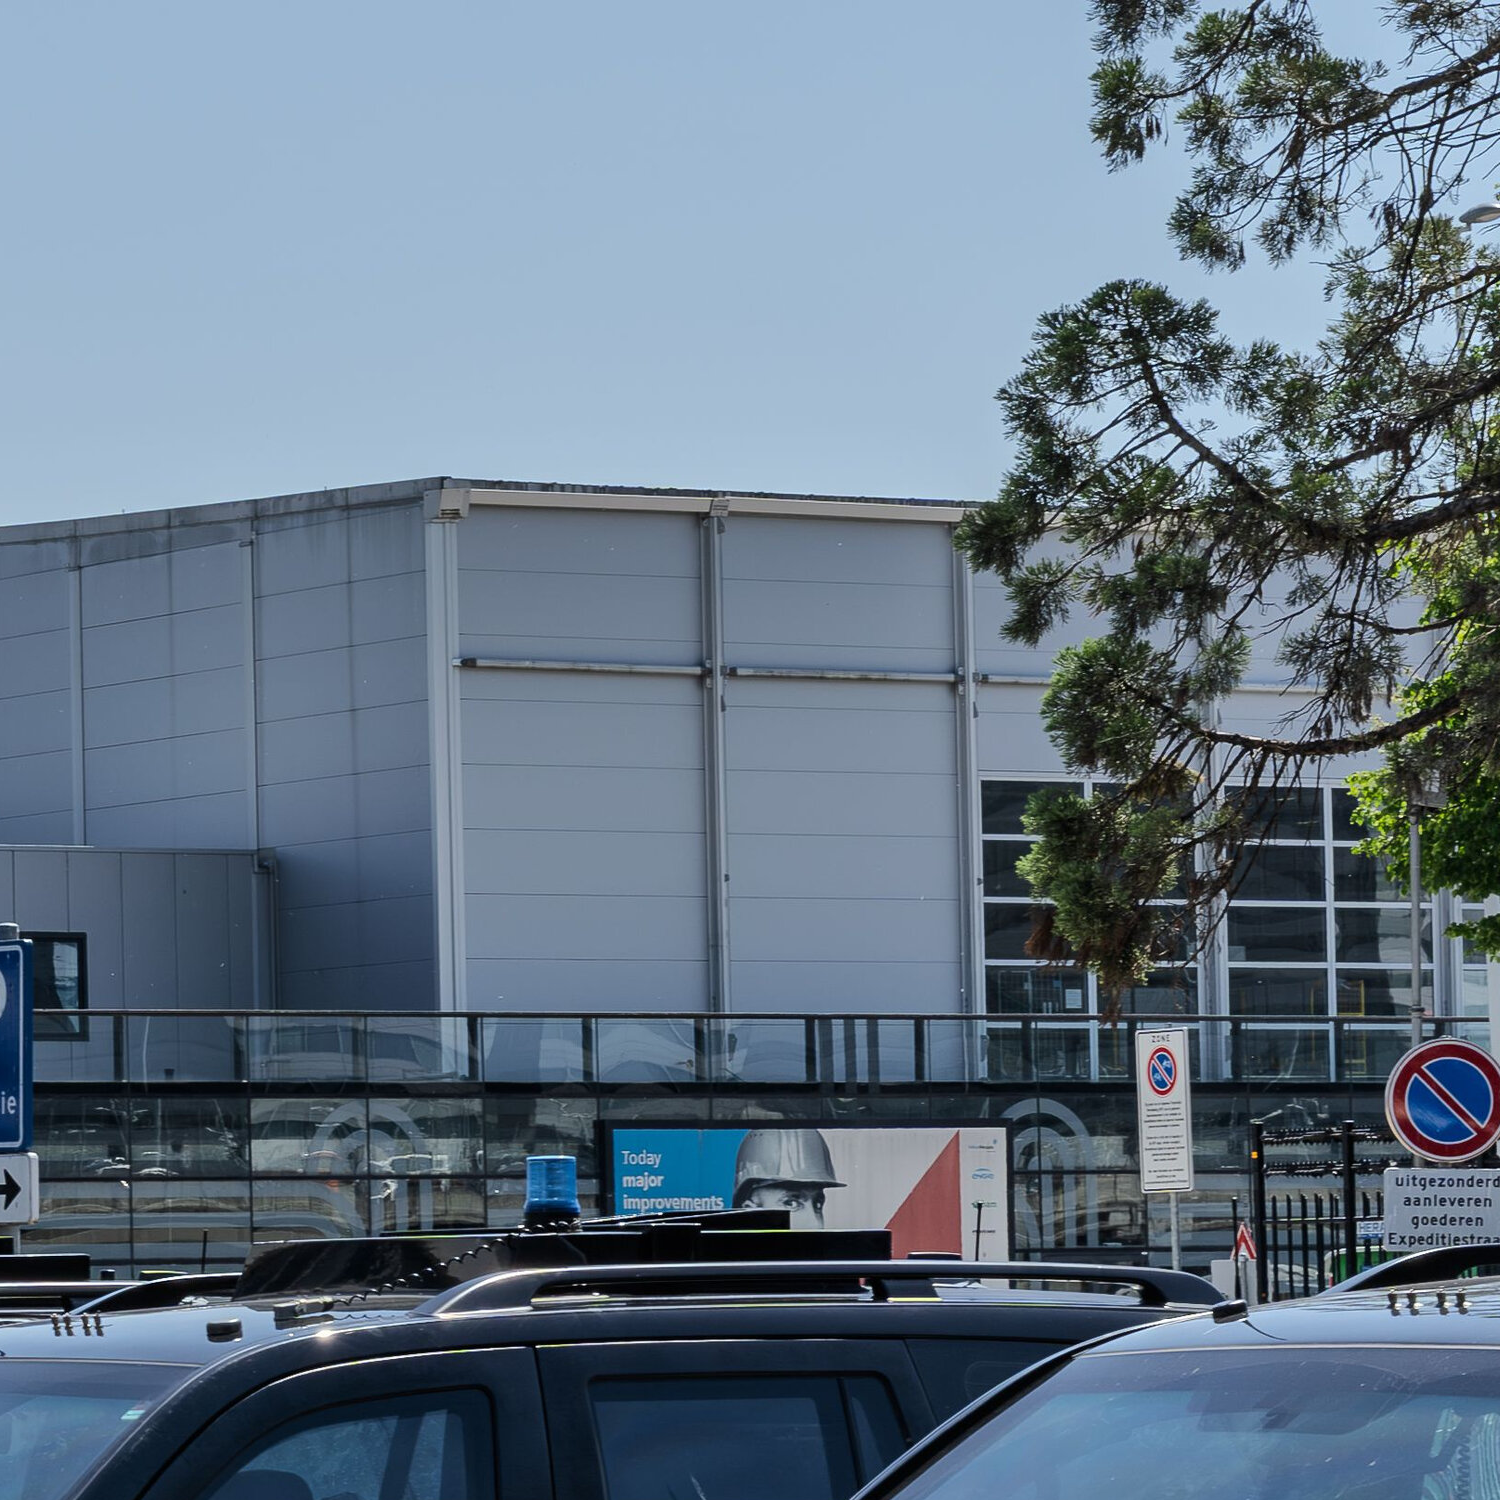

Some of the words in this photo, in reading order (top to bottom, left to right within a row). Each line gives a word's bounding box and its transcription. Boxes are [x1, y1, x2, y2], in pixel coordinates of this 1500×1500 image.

[621, 1149, 662, 1168] Today
[622, 1171, 665, 1191] major
[1395, 1174, 1500, 1191] uitgezonderd
[623, 1194, 725, 1213] improvements
[1403, 1194, 1493, 1207] aanleveren
[1411, 1213, 1484, 1229] goederen
